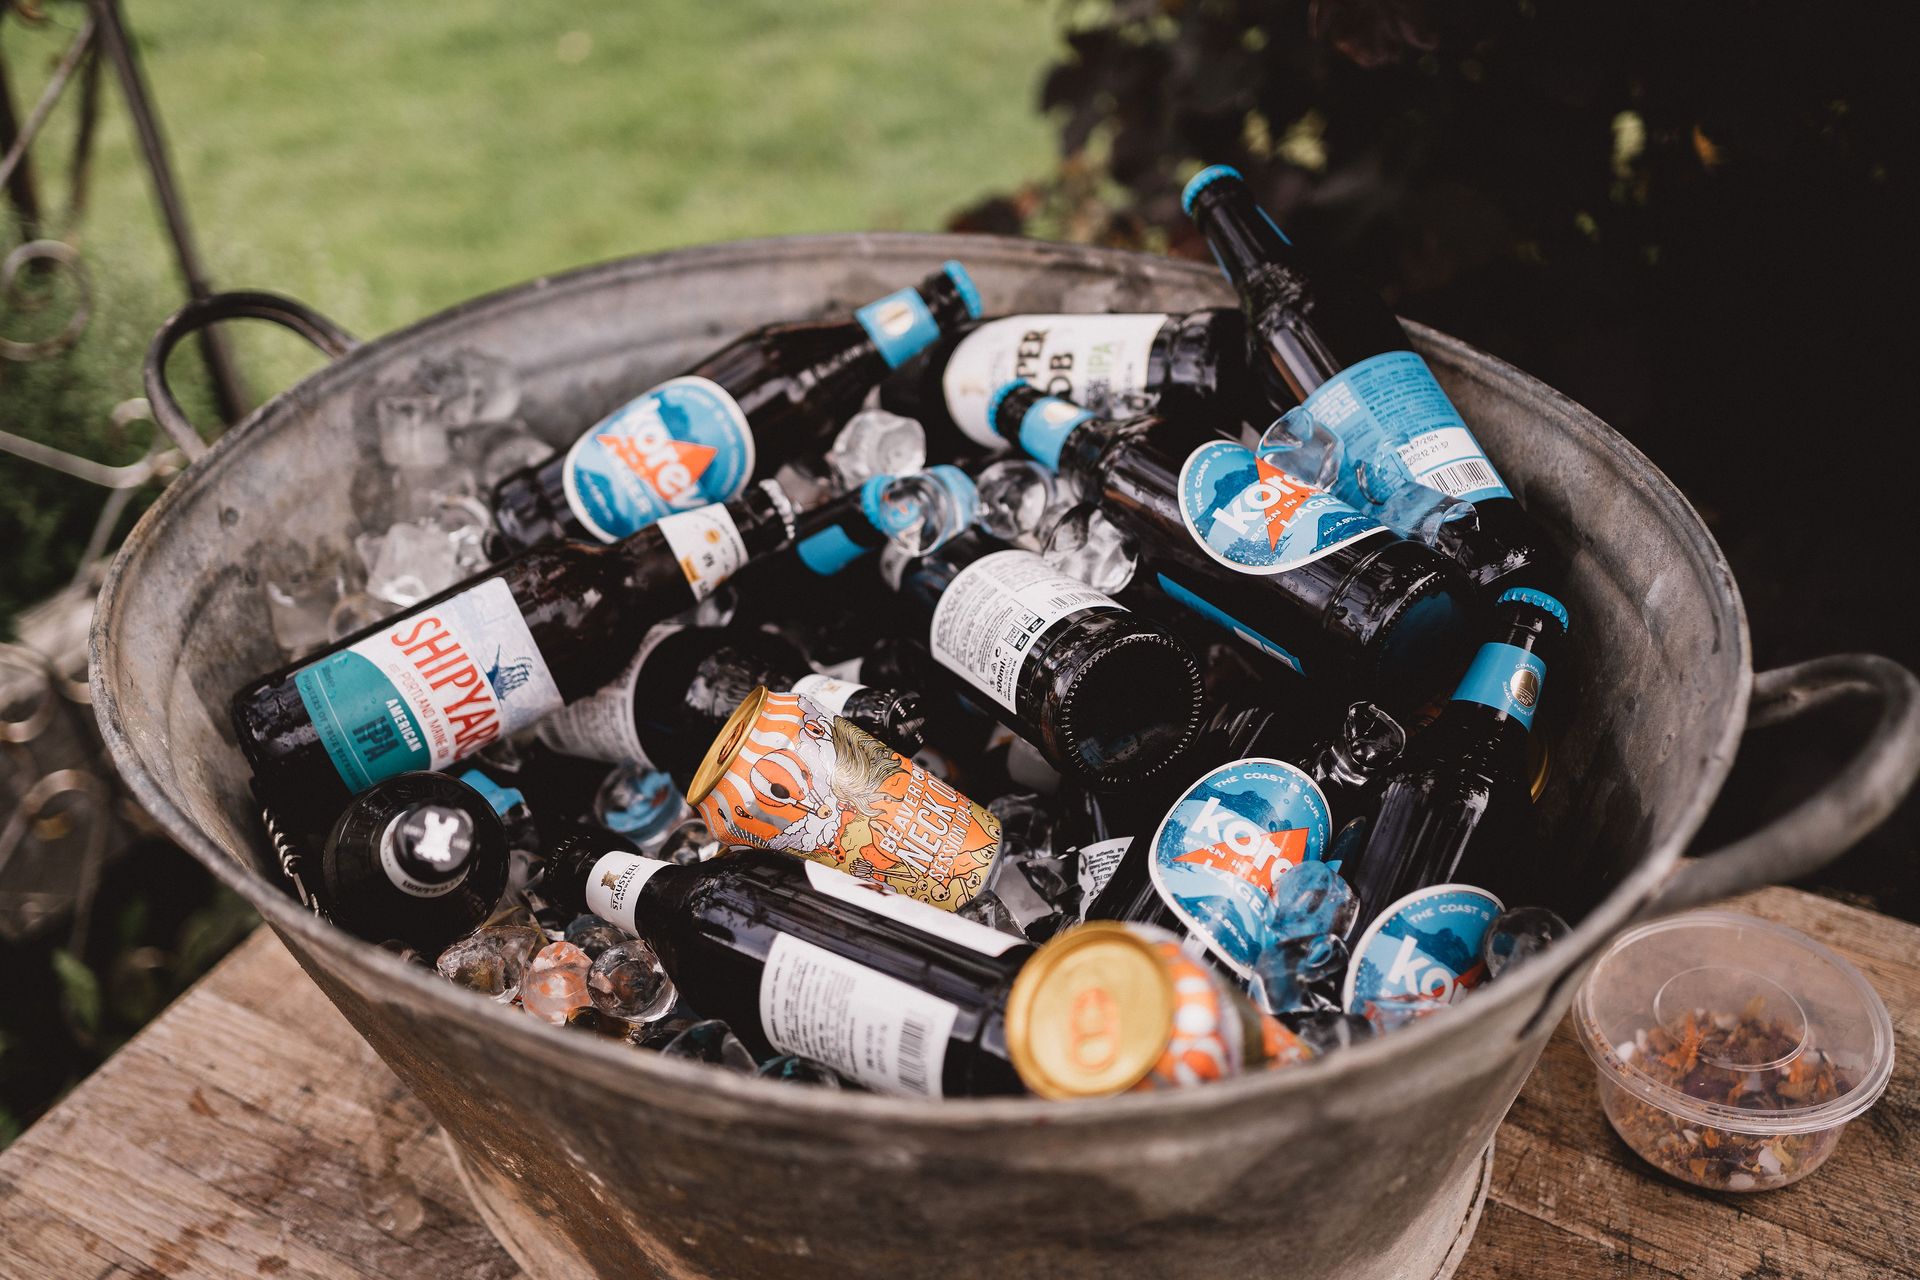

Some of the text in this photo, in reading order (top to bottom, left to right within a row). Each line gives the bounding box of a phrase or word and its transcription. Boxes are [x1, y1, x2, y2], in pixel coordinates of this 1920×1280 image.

[1194, 458, 1212, 489] COAST
[1250, 498, 1298, 541] BORN IN
[1280, 497, 1338, 529] LAGE
[391, 616, 500, 762] SHIPYAR
[996, 660, 1007, 695] 500ml
[352, 715, 400, 763] IPA
[385, 698, 423, 753] AMERICAN
[1213, 775, 1239, 789] THE
[1243, 772, 1287, 784] COAST
[1289, 782, 1301, 793] IS
[1303, 794, 1320, 820] OUR
[895, 791, 957, 873] NECK
[928, 823, 967, 882] SESSION
[955, 804, 972, 827] IPA
[1183, 837, 1226, 859] BORN
[612, 864, 640, 911] ST AUSTELL
[1203, 858, 1265, 918] LAGE
[1409, 908, 1435, 924] THE
[1439, 903, 1479, 915] COAST
